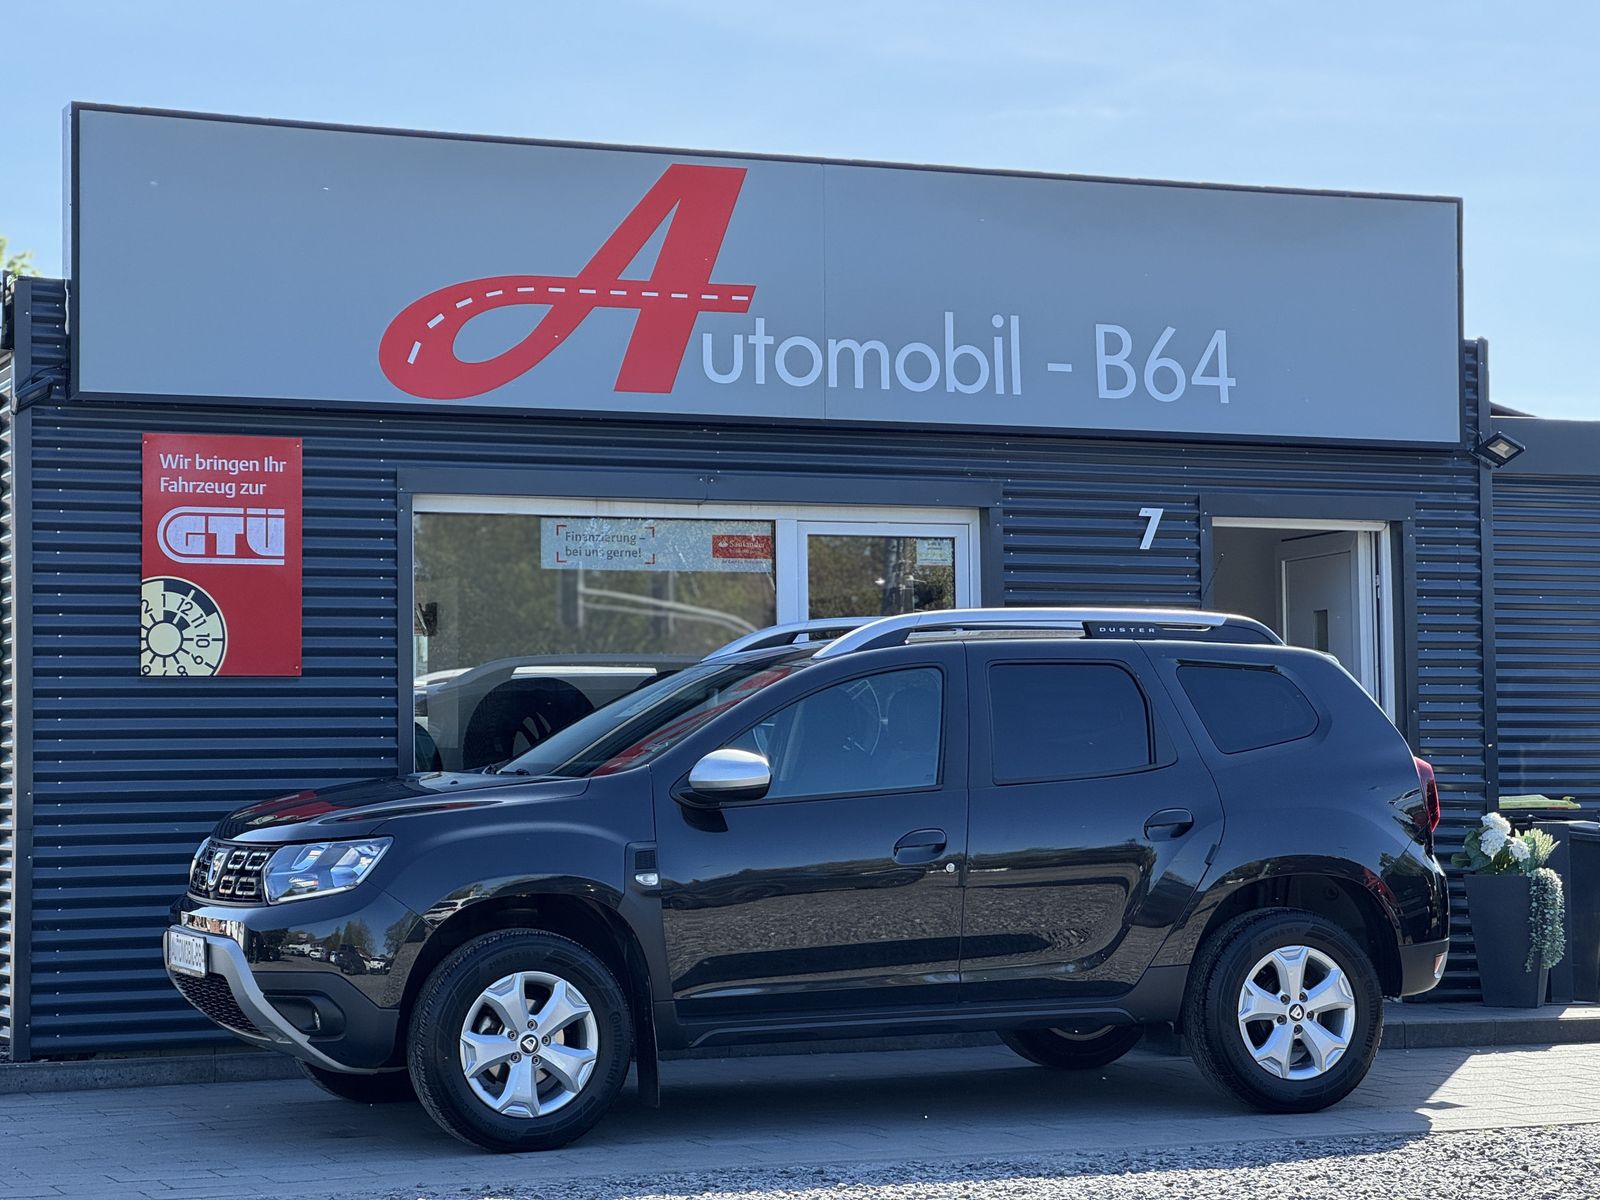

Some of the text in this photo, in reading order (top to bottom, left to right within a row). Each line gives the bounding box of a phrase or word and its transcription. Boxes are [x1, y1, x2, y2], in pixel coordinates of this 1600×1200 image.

[379, 163, 1022, 400] Automobil
[1095, 323, 1236, 404] B64
[160, 453, 287, 475] Wir bringen Ihr
[160, 476, 267, 498] Fahrzeug zur
[164, 507, 285, 557] GTÜ
[1138, 507, 1164, 550] 7
[565, 546, 582, 557] bei
[607, 548, 642, 560] gerne!
[161, 593, 166, 608] 1
[177, 597, 194, 616] 12
[191, 613, 207, 628] 11
[196, 632, 210, 648] 10
